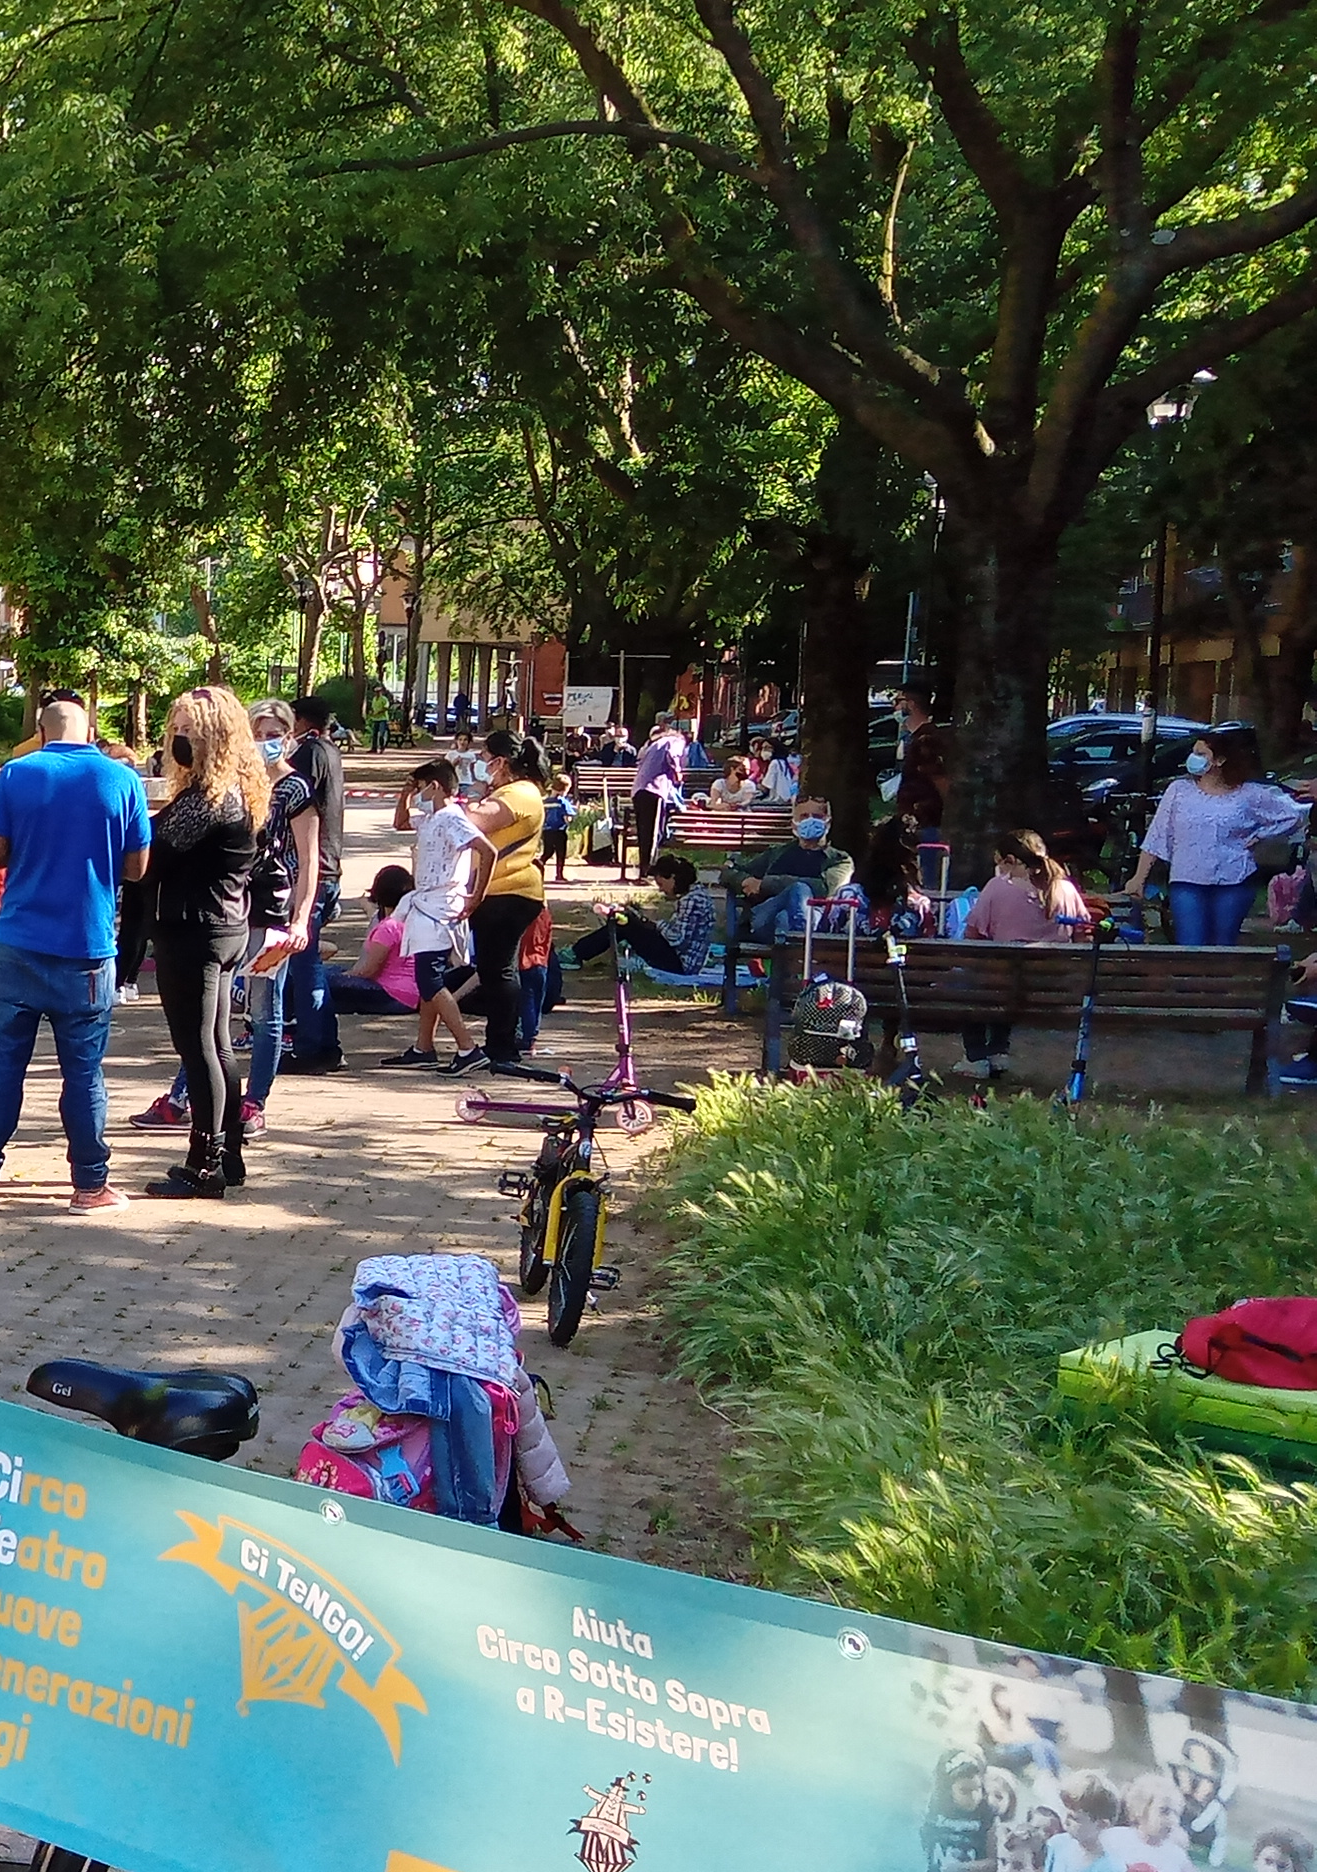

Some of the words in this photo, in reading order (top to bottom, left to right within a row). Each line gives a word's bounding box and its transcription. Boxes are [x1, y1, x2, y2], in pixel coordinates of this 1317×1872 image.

[52, 1382, 73, 1397] Gel
[240, 1538, 270, 1579] Ci
[276, 1557, 375, 1661] TeNGO!
[572, 1606, 654, 1660] Aiuta
[476, 1624, 561, 1676] Circo
[567, 1648, 658, 1705] Sotto
[664, 1678, 771, 1735] Sopra
[516, 1686, 536, 1715] a
[543, 1684, 740, 1773] R-Esistere!
